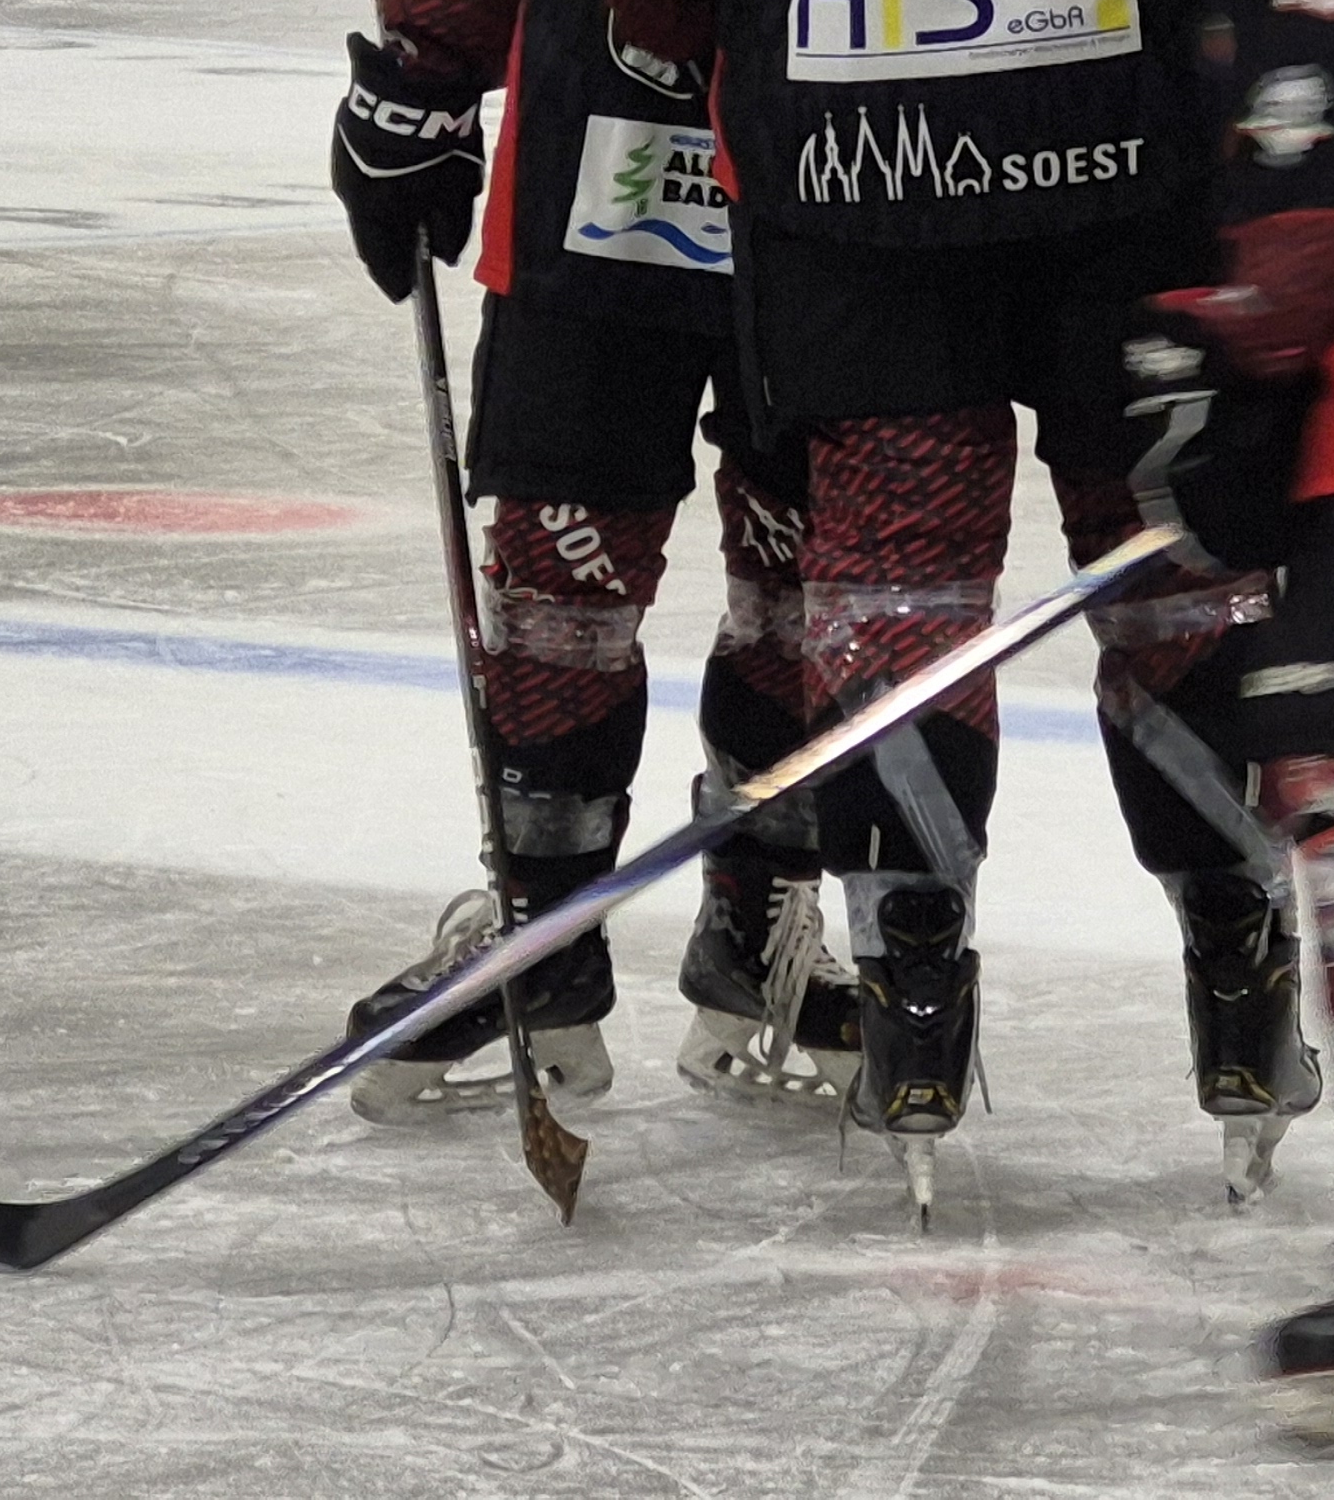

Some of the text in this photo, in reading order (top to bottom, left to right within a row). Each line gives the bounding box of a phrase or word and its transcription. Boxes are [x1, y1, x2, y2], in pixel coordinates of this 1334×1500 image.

[348, 81, 478, 140] CCM
[664, 150, 716, 178] AL
[1002, 137, 1145, 192] SOEST
